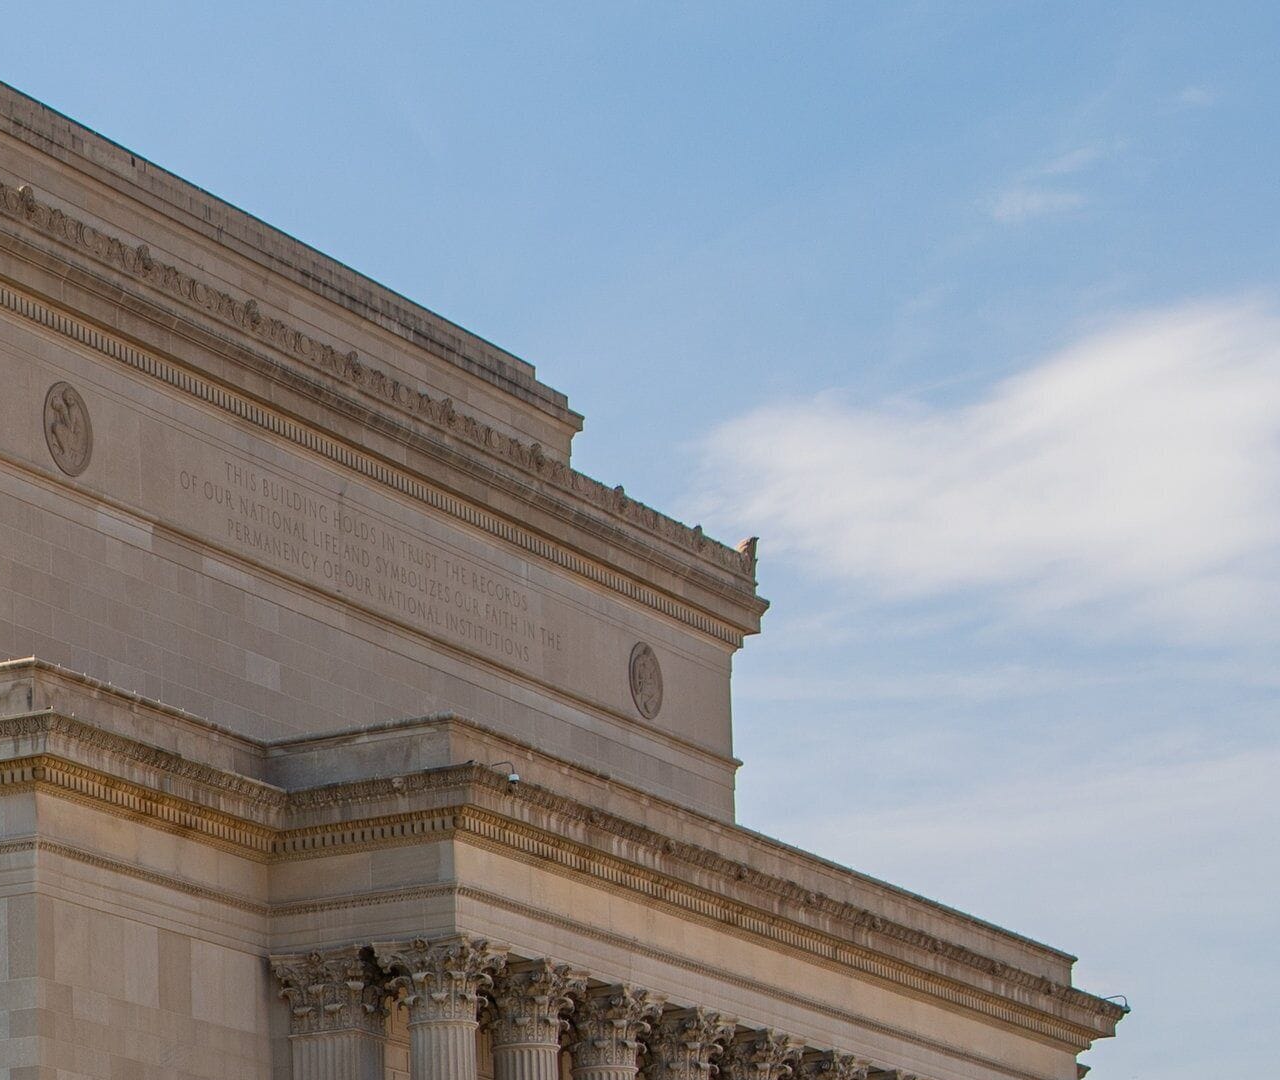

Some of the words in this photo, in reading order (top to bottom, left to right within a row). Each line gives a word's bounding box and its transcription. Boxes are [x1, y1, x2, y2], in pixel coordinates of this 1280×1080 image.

[179, 470, 197, 492] OF
[203, 481, 234, 510] OUR
[239, 497, 308, 543] NATIONAL
[313, 531, 339, 555] LIFE
[343, 545, 371, 568] AND
[375, 556, 450, 604] SYMBOLIZES
[455, 591, 480, 617] OUR
[485, 603, 518, 632] FAITH
[523, 618, 536, 640] IN
[540, 627, 562, 650] THE
[224, 461, 257, 492] THIS
[262, 478, 329, 524] BUILDING
[333, 511, 377, 545] HOLDS
[382, 531, 395, 554] IN
[400, 539, 439, 573] TRUST
[445, 560, 468, 584] THE
[472, 572, 528, 612] RECORDS
[227, 518, 318, 573] PERMANENCY
[323, 560, 340, 582] OF
[344, 569, 372, 595] OUR
[378, 585, 441, 625] NATIONAL
[445, 612, 530, 662] INSTITUTIONS
